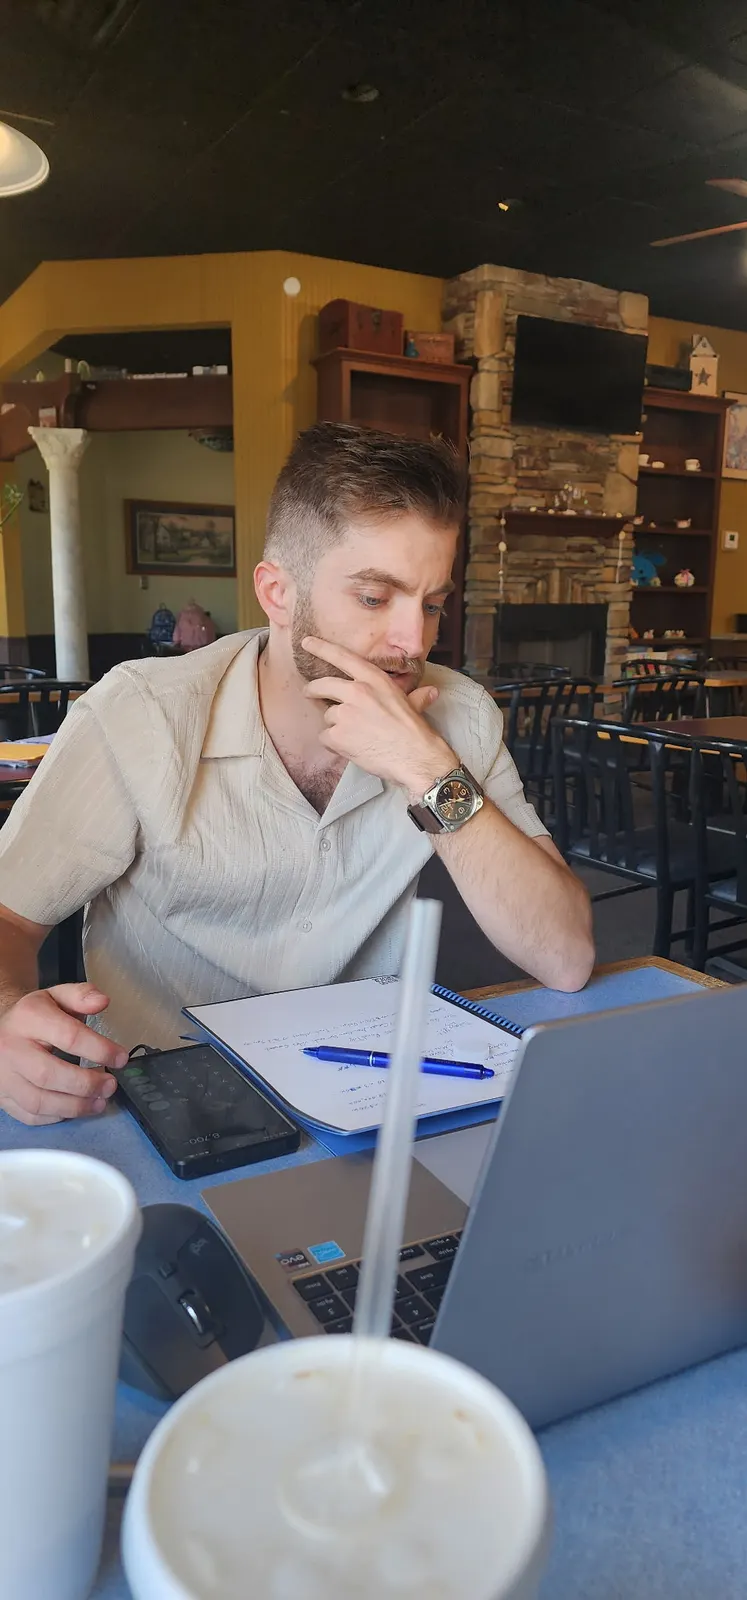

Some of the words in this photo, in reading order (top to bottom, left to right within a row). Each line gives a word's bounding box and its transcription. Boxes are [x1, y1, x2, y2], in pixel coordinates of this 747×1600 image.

[443, 787, 450, 795] 3
[460, 788, 467, 796] 6
[458, 806, 465, 814] 9
[280, 1254, 305, 1265] evo
